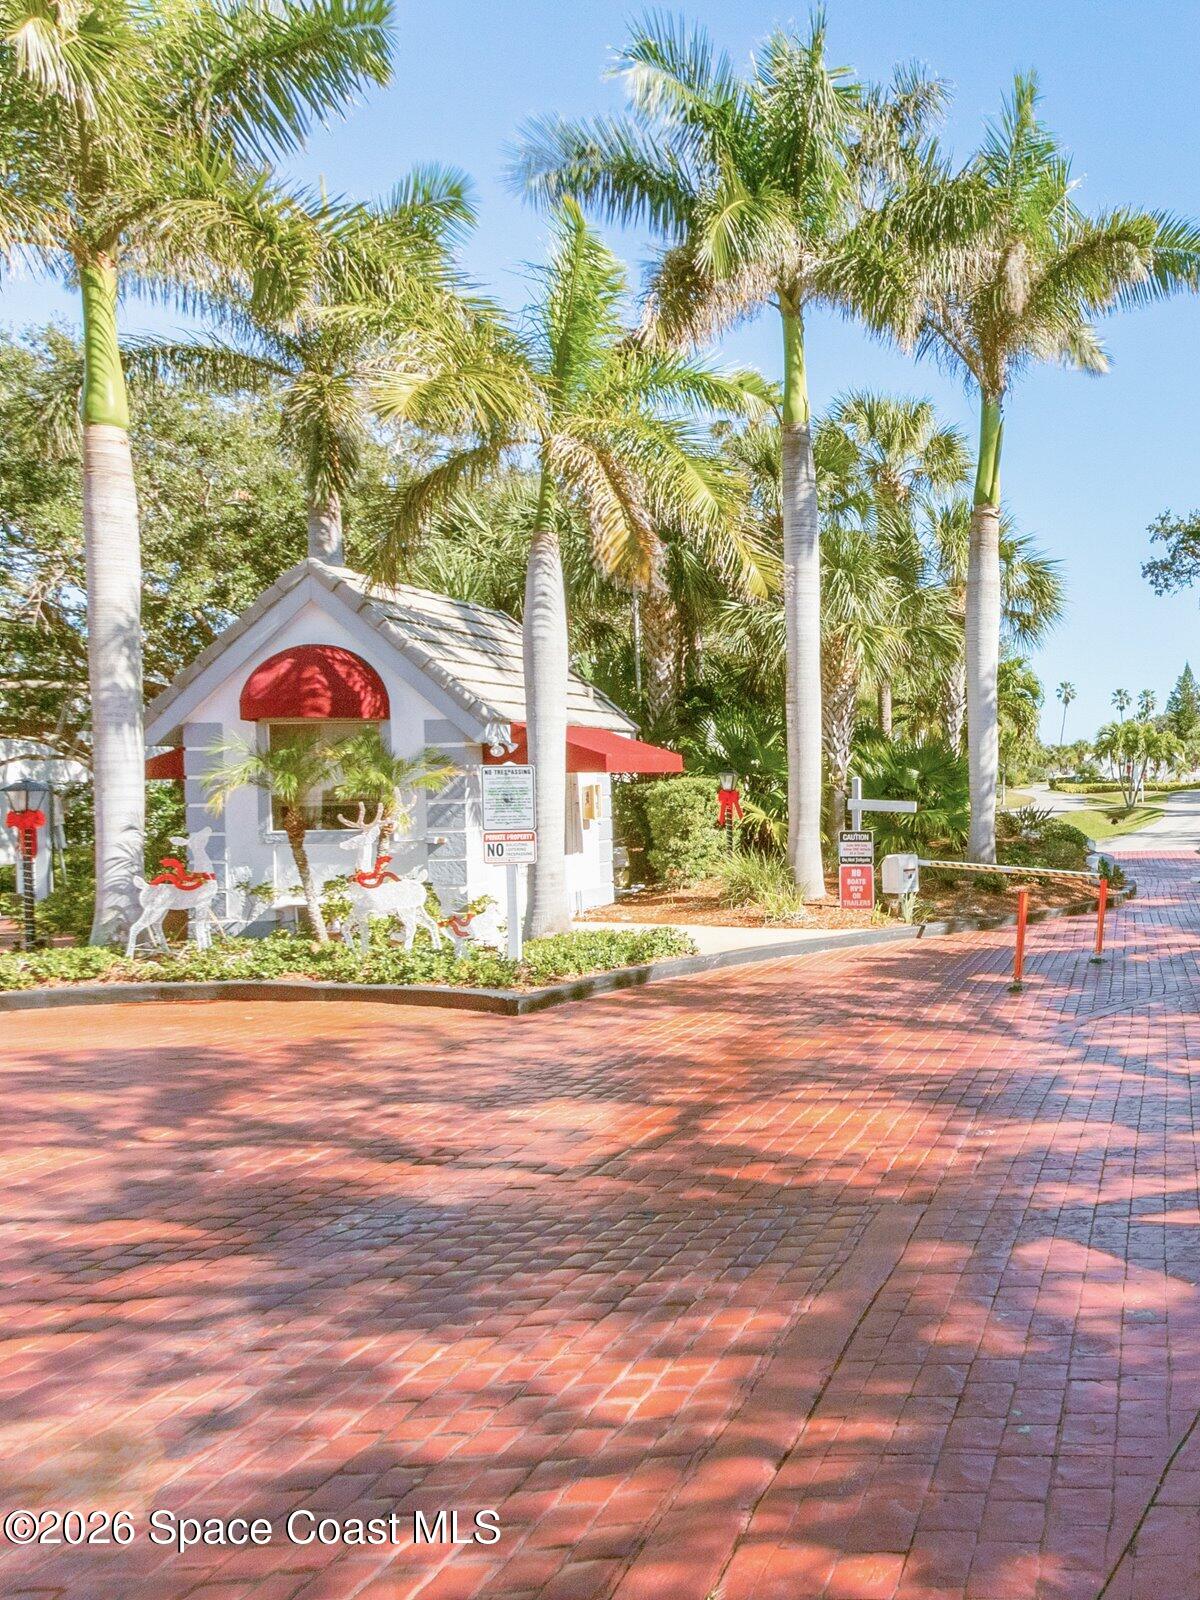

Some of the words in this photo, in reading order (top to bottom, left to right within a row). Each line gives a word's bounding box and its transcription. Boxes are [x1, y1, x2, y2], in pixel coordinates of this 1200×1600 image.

[842, 833, 869, 841] CAUTION
[487, 843, 504, 857] NO
[846, 878, 866, 886] BOATS
[843, 899, 871, 907] TRAILERS
